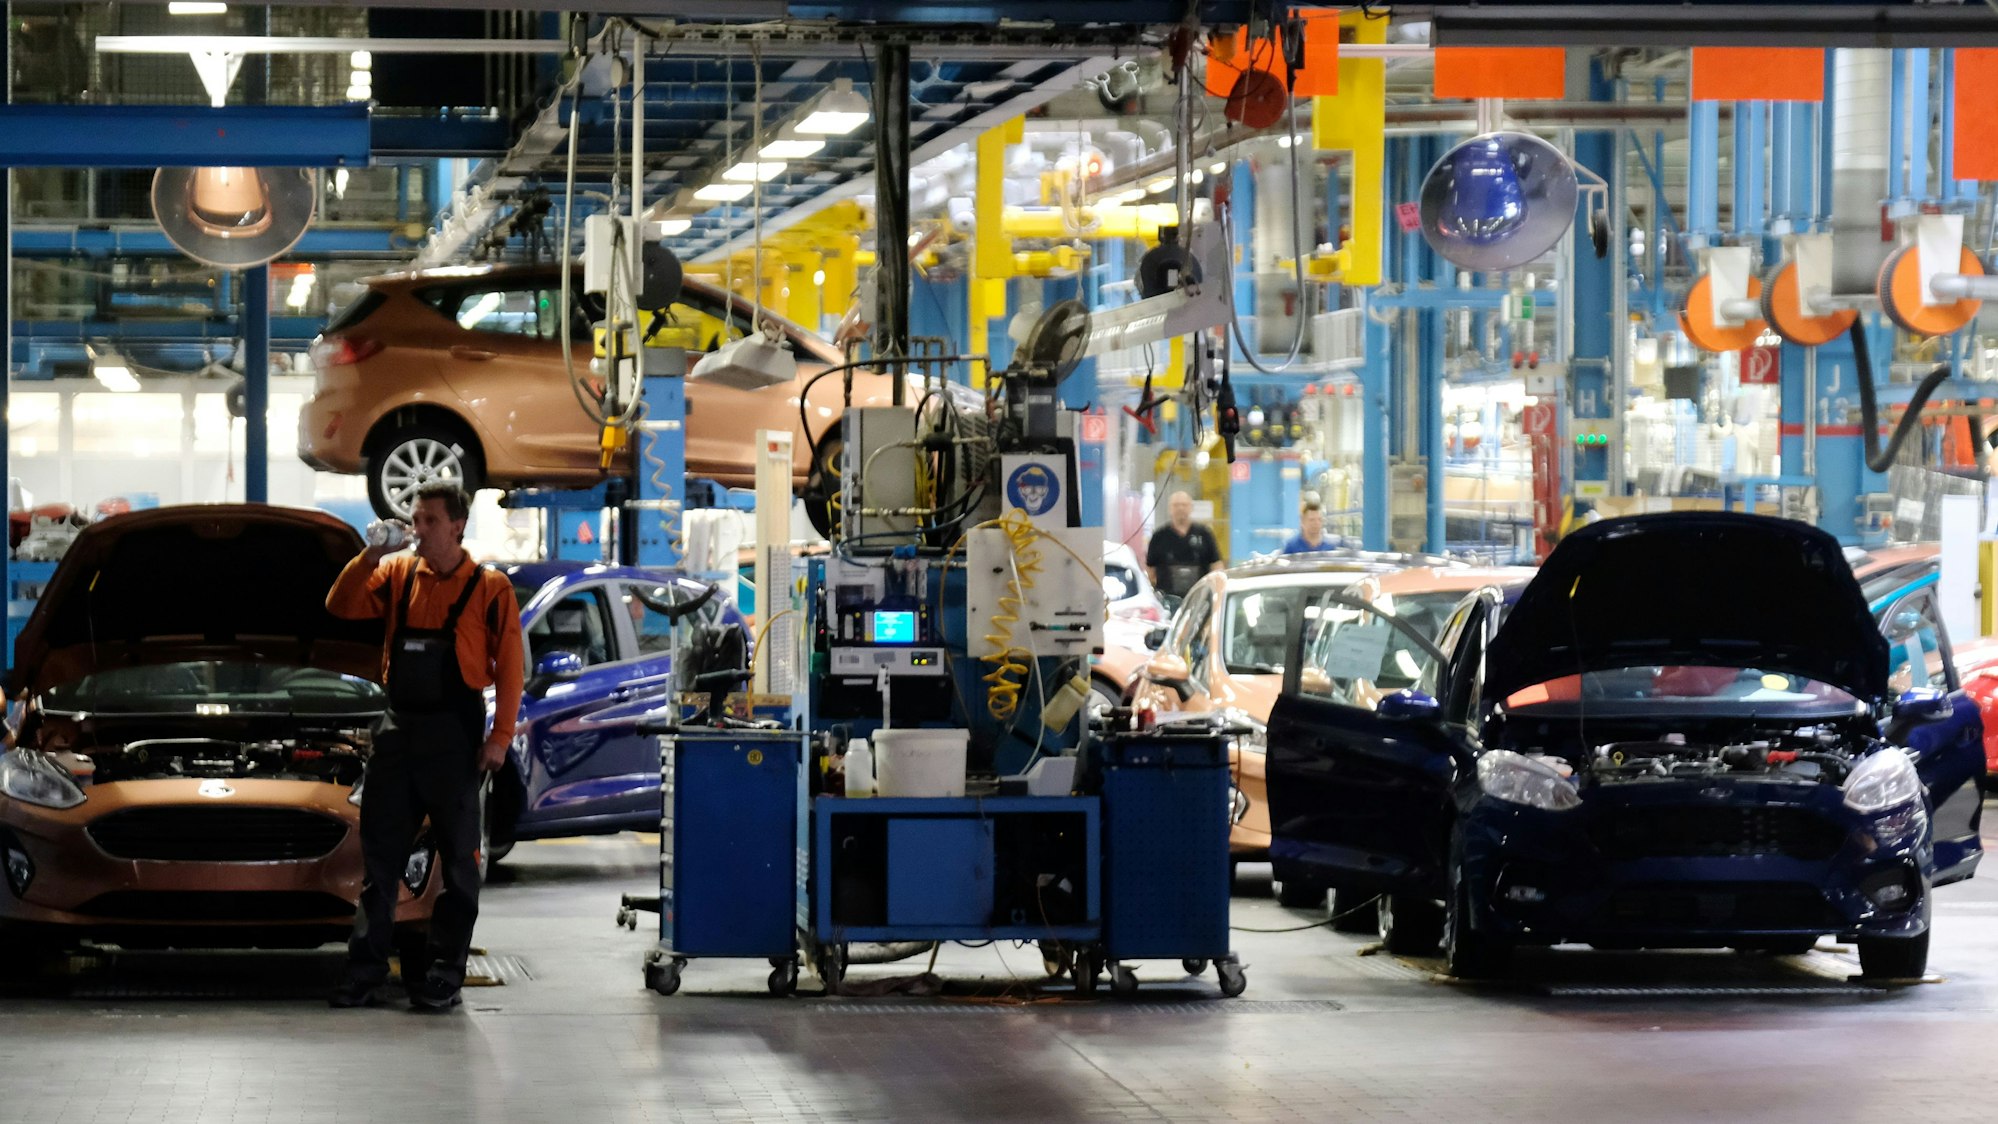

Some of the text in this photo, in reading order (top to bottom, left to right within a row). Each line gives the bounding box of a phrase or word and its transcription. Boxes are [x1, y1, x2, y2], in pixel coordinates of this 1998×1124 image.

[1826, 364, 1840, 394] J
[1579, 388, 1597, 415] H
[1820, 397, 1848, 424] 13
